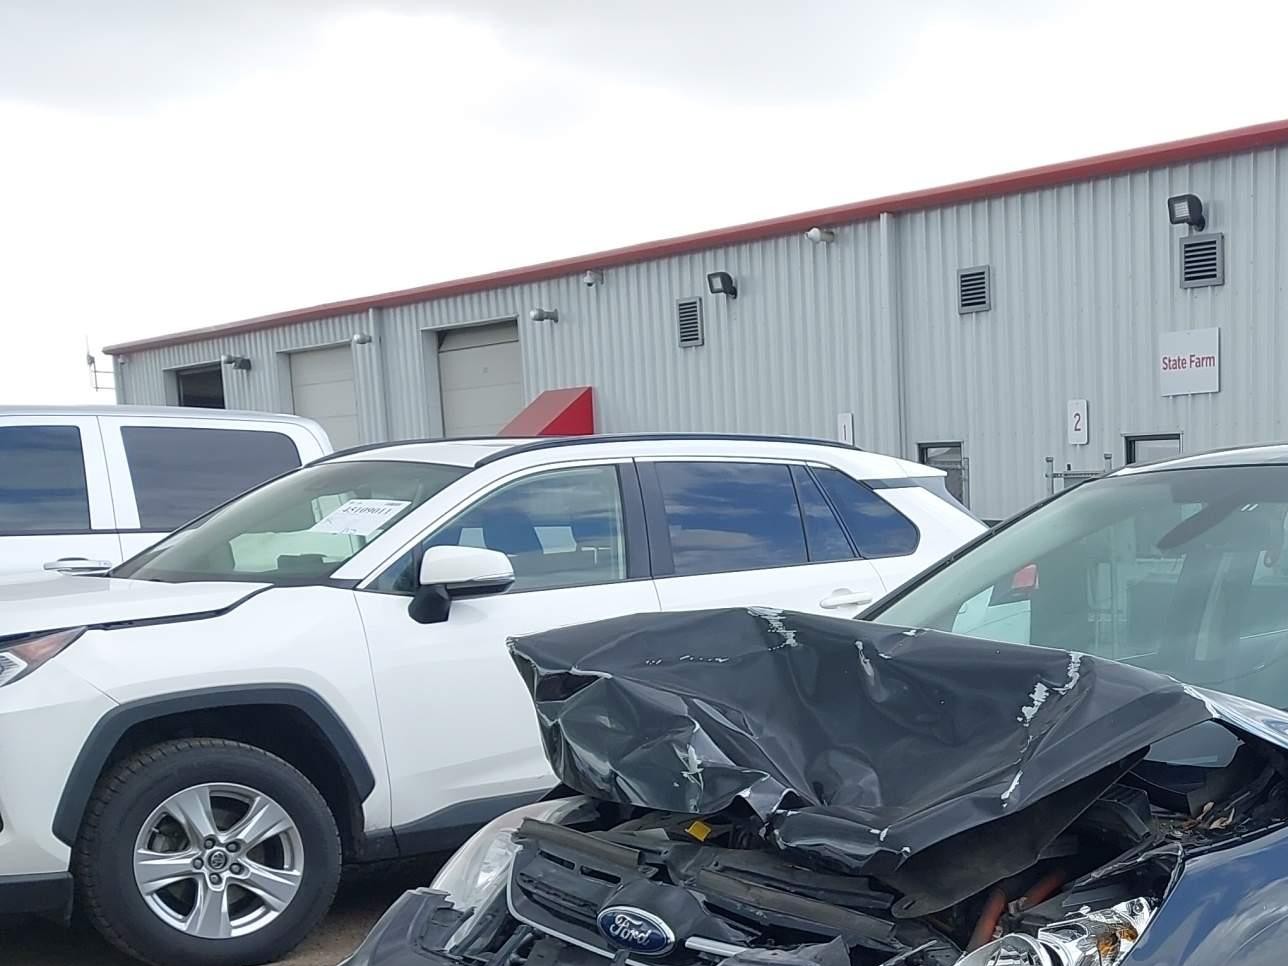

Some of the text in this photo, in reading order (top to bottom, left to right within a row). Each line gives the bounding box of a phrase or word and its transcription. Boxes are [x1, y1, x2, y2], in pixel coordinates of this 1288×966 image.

[1161, 354, 1216, 371] State Farm
[1073, 412, 1083, 432] 2
[609, 914, 653, 945] Ford
